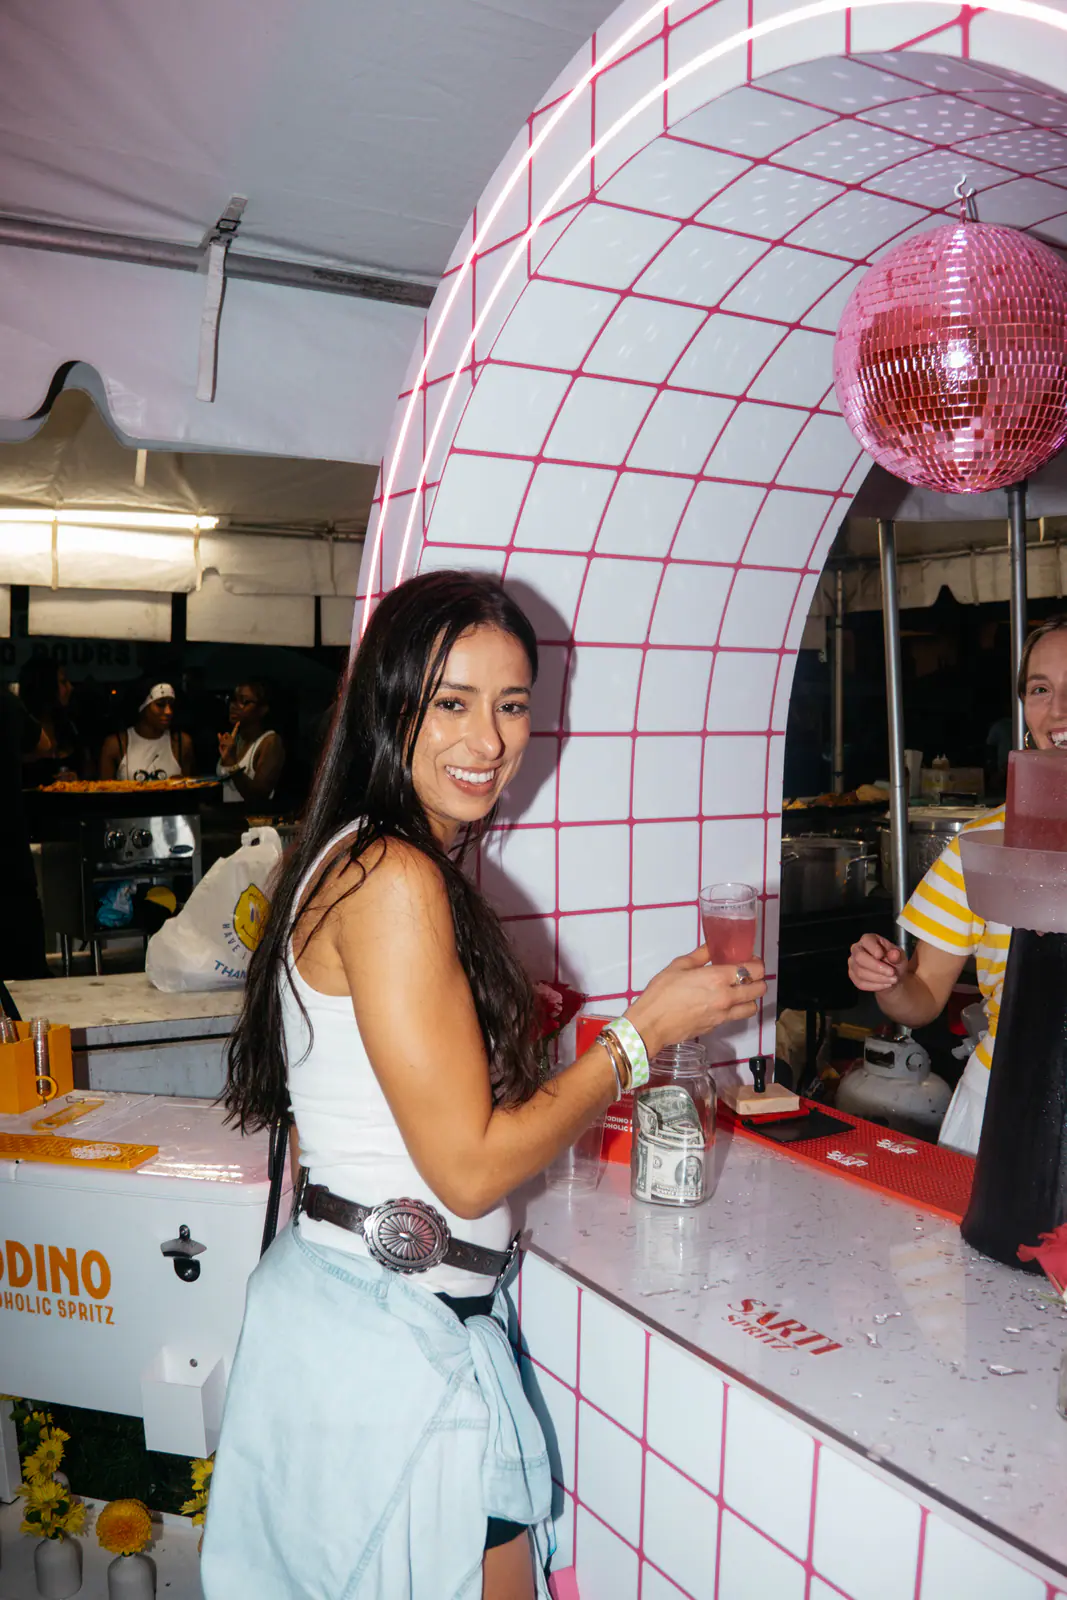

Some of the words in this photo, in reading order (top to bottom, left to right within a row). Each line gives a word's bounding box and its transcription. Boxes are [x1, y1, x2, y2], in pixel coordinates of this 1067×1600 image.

[222, 923, 241, 953] HAVE
[0, 1239, 111, 1300] DINO
[0, 1291, 51, 1316] HOLIC
[57, 1299, 116, 1325] SPRITZ
[721, 1314, 798, 1353] SPRITZ
